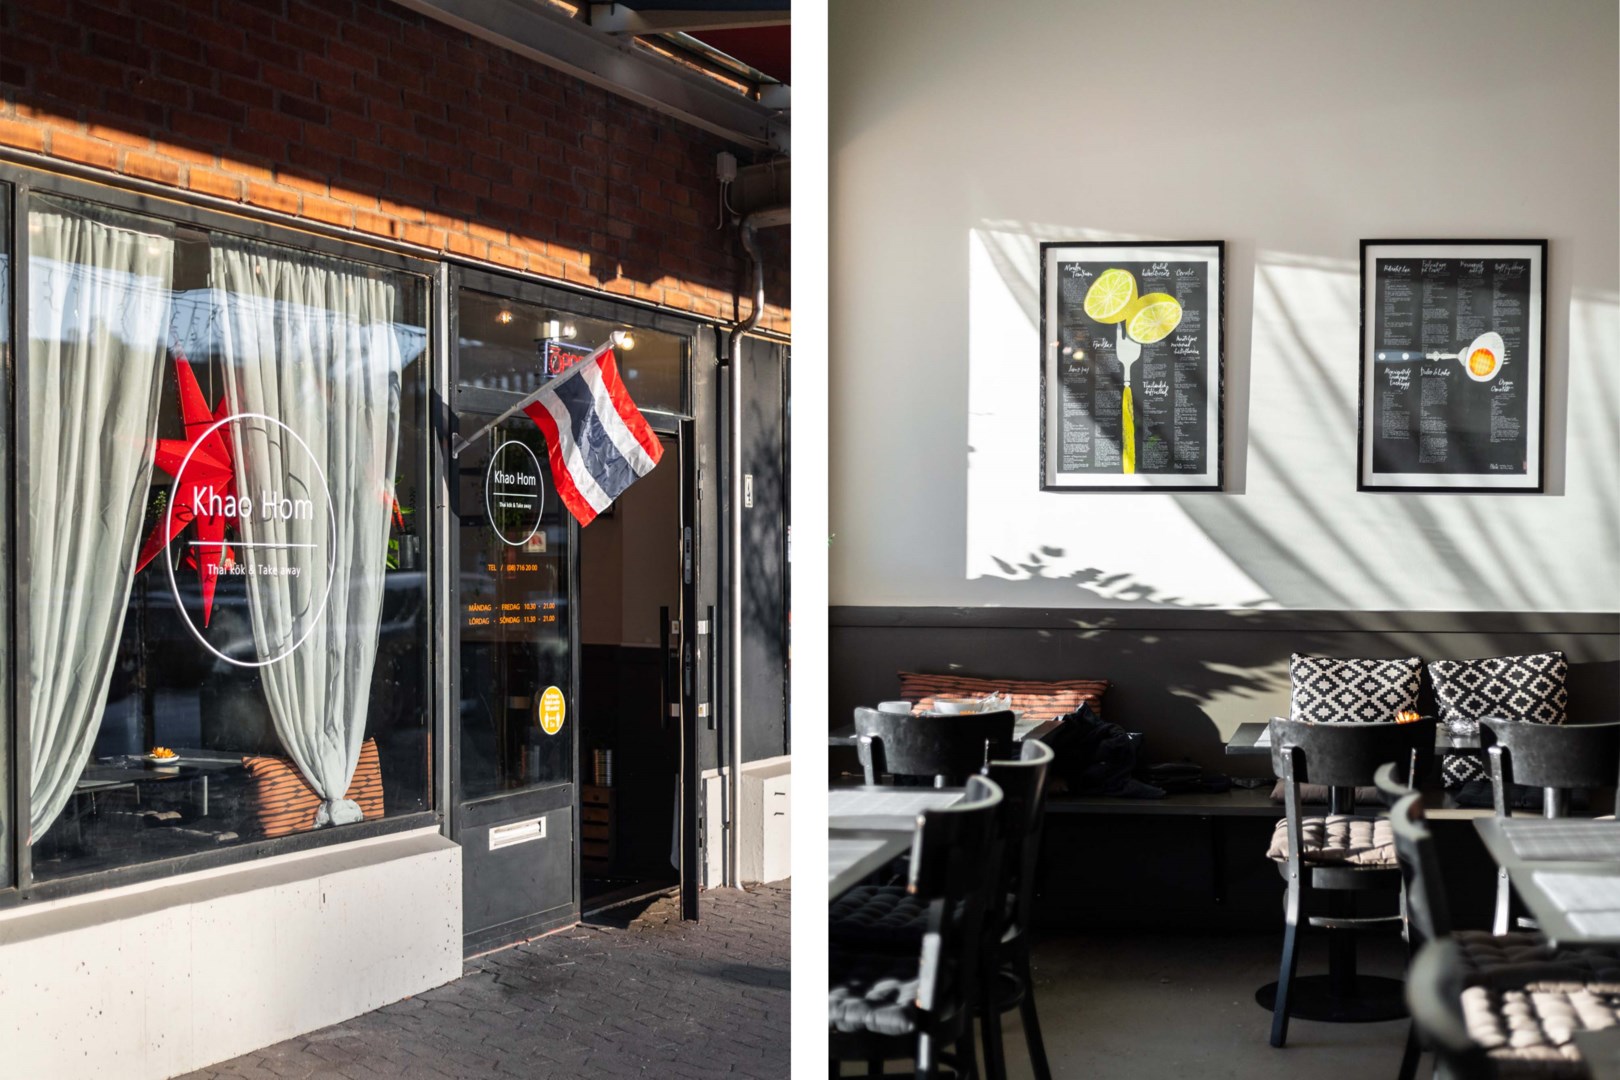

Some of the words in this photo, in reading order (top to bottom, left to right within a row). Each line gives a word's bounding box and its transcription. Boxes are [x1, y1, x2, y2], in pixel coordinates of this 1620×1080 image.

[493, 470, 515, 485] Khao
[516, 472, 536, 486] Hom
[193, 485, 253, 518] Khao
[262, 490, 314, 520] Hom
[207, 564, 228, 576] Thai
[230, 564, 246, 576] kök
[248, 565, 255, 576] &
[258, 564, 278, 576] Take
[280, 567, 301, 578] away
[488, 563, 497, 571] TEL
[468, 603, 492, 612] MÅNDAG
[501, 603, 520, 611] FREDAG
[468, 617, 490, 625] LÖRDAG
[499, 616, 520, 624] SÖNDAG
